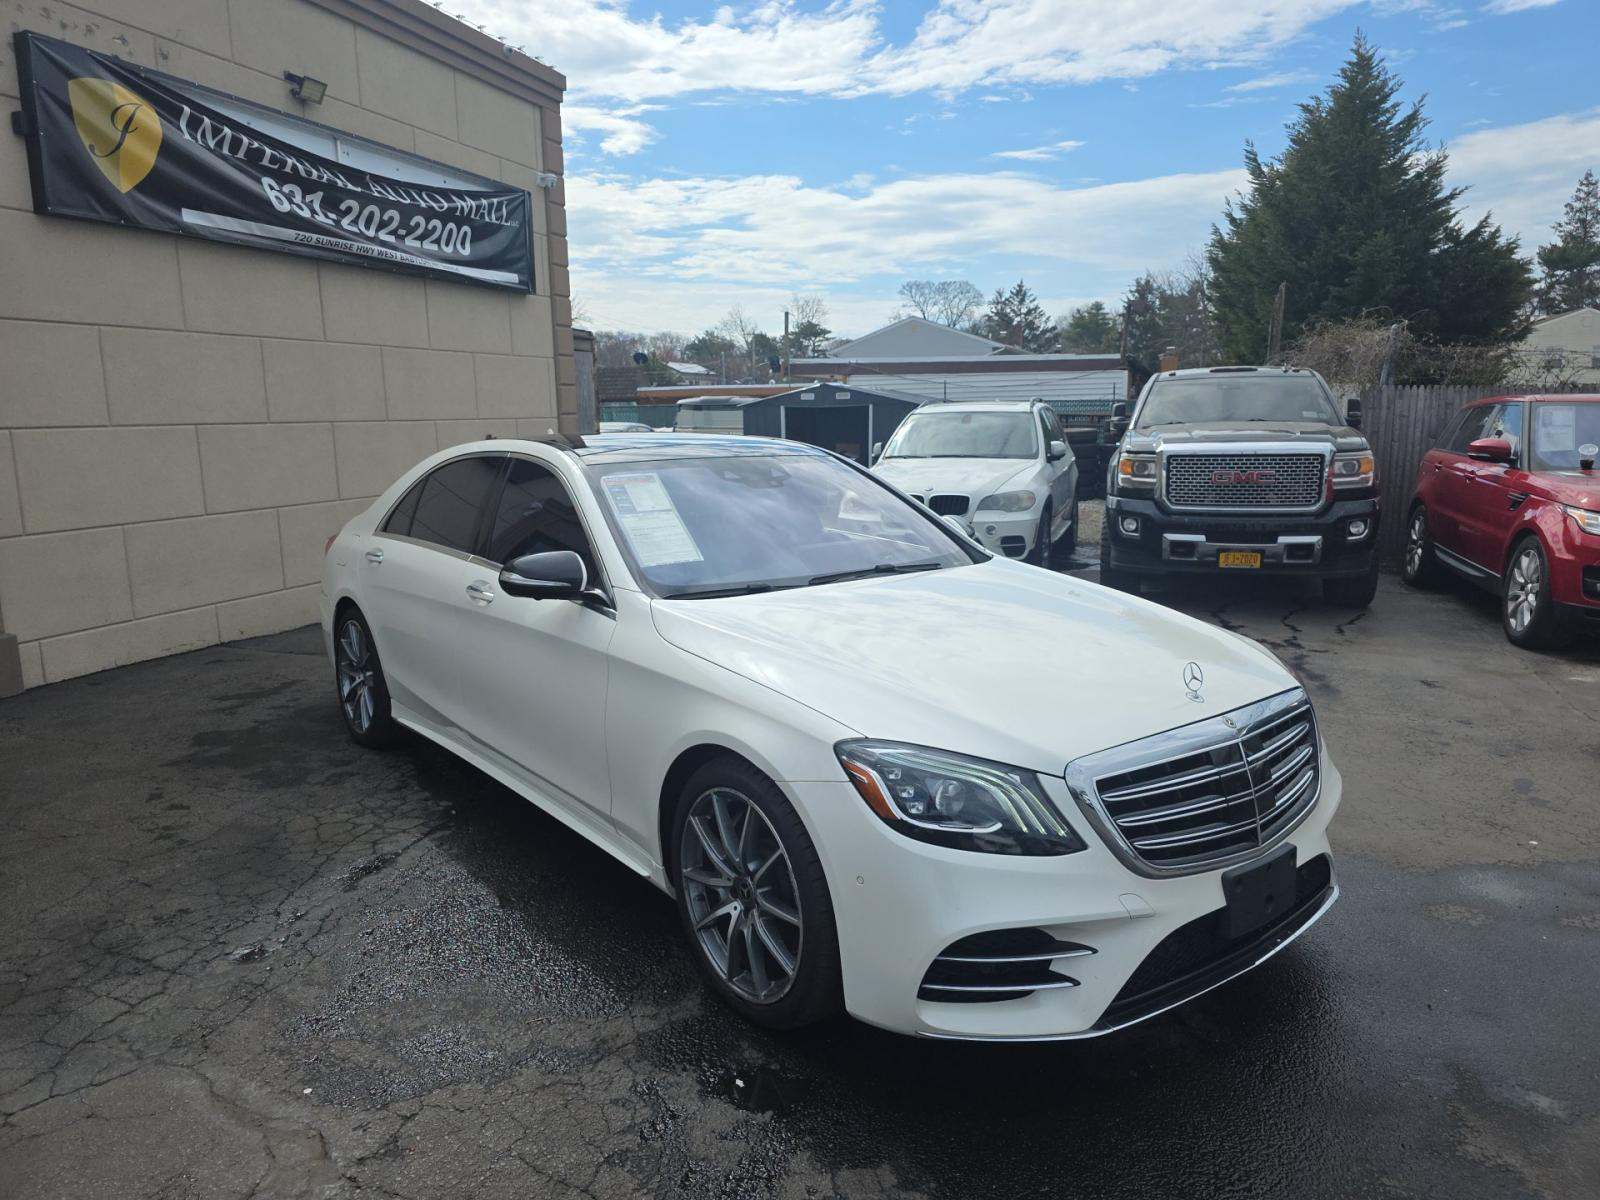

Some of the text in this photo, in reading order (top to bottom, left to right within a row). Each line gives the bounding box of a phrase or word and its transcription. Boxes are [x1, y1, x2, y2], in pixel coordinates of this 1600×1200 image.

[261, 176, 472, 256] 631-202-2200
[366, 174, 449, 212] AUTO
[449, 191, 511, 227] MALL
[294, 232, 313, 243] 720
[314, 236, 355, 251] SUNRISE
[356, 245, 376, 255] HWY
[376, 248, 398, 260] WEST
[1211, 470, 1275, 484] GMC
